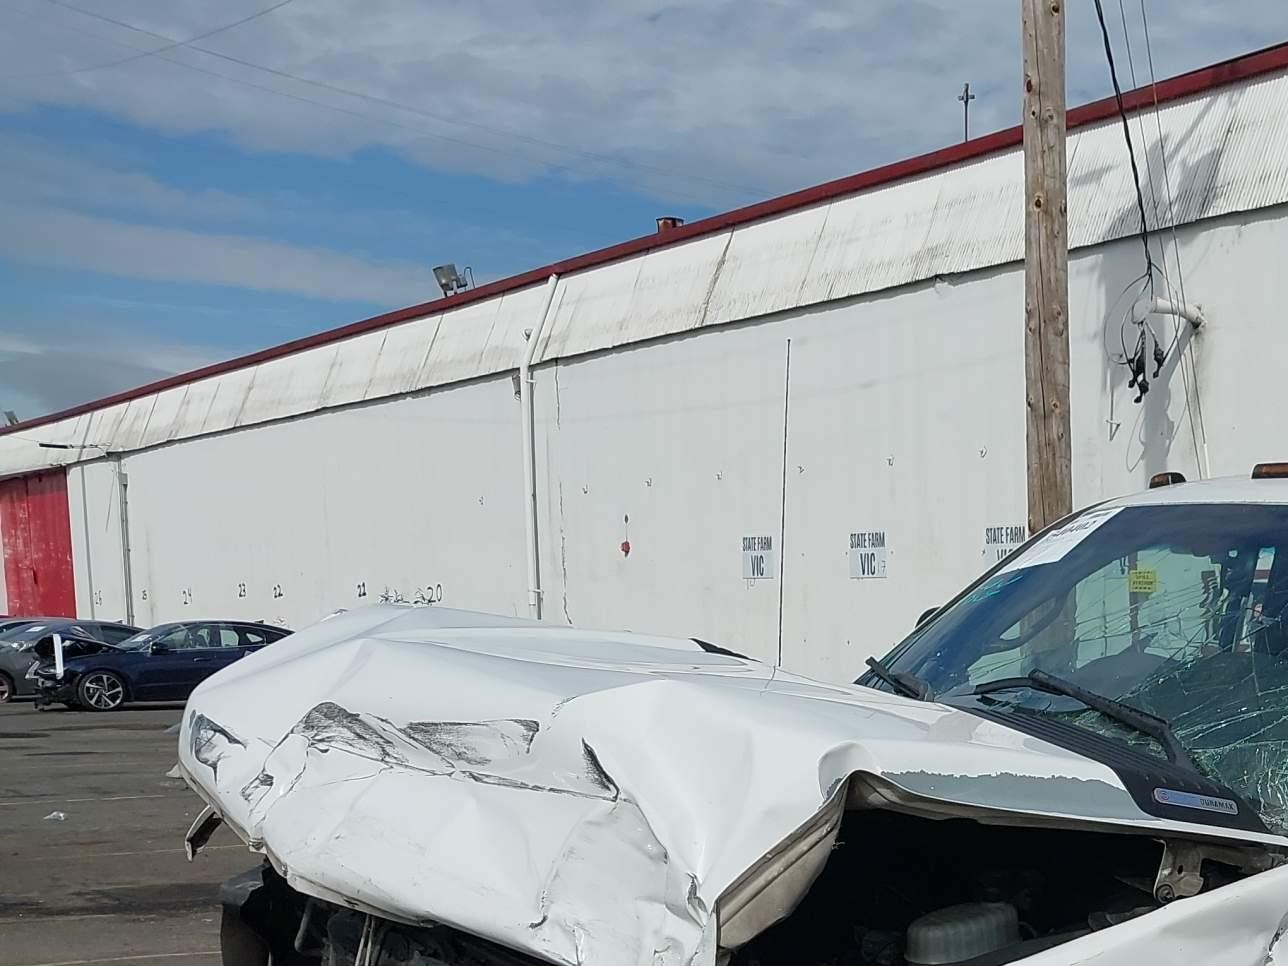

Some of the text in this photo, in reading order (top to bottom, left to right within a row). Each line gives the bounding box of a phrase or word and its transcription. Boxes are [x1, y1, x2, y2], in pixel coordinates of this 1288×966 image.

[742, 536, 772, 552] STATE FARM
[850, 532, 885, 549] STATE FARM
[985, 526, 1026, 545] STATE FARM
[750, 555, 765, 577] VIC
[860, 553, 876, 576] VIC
